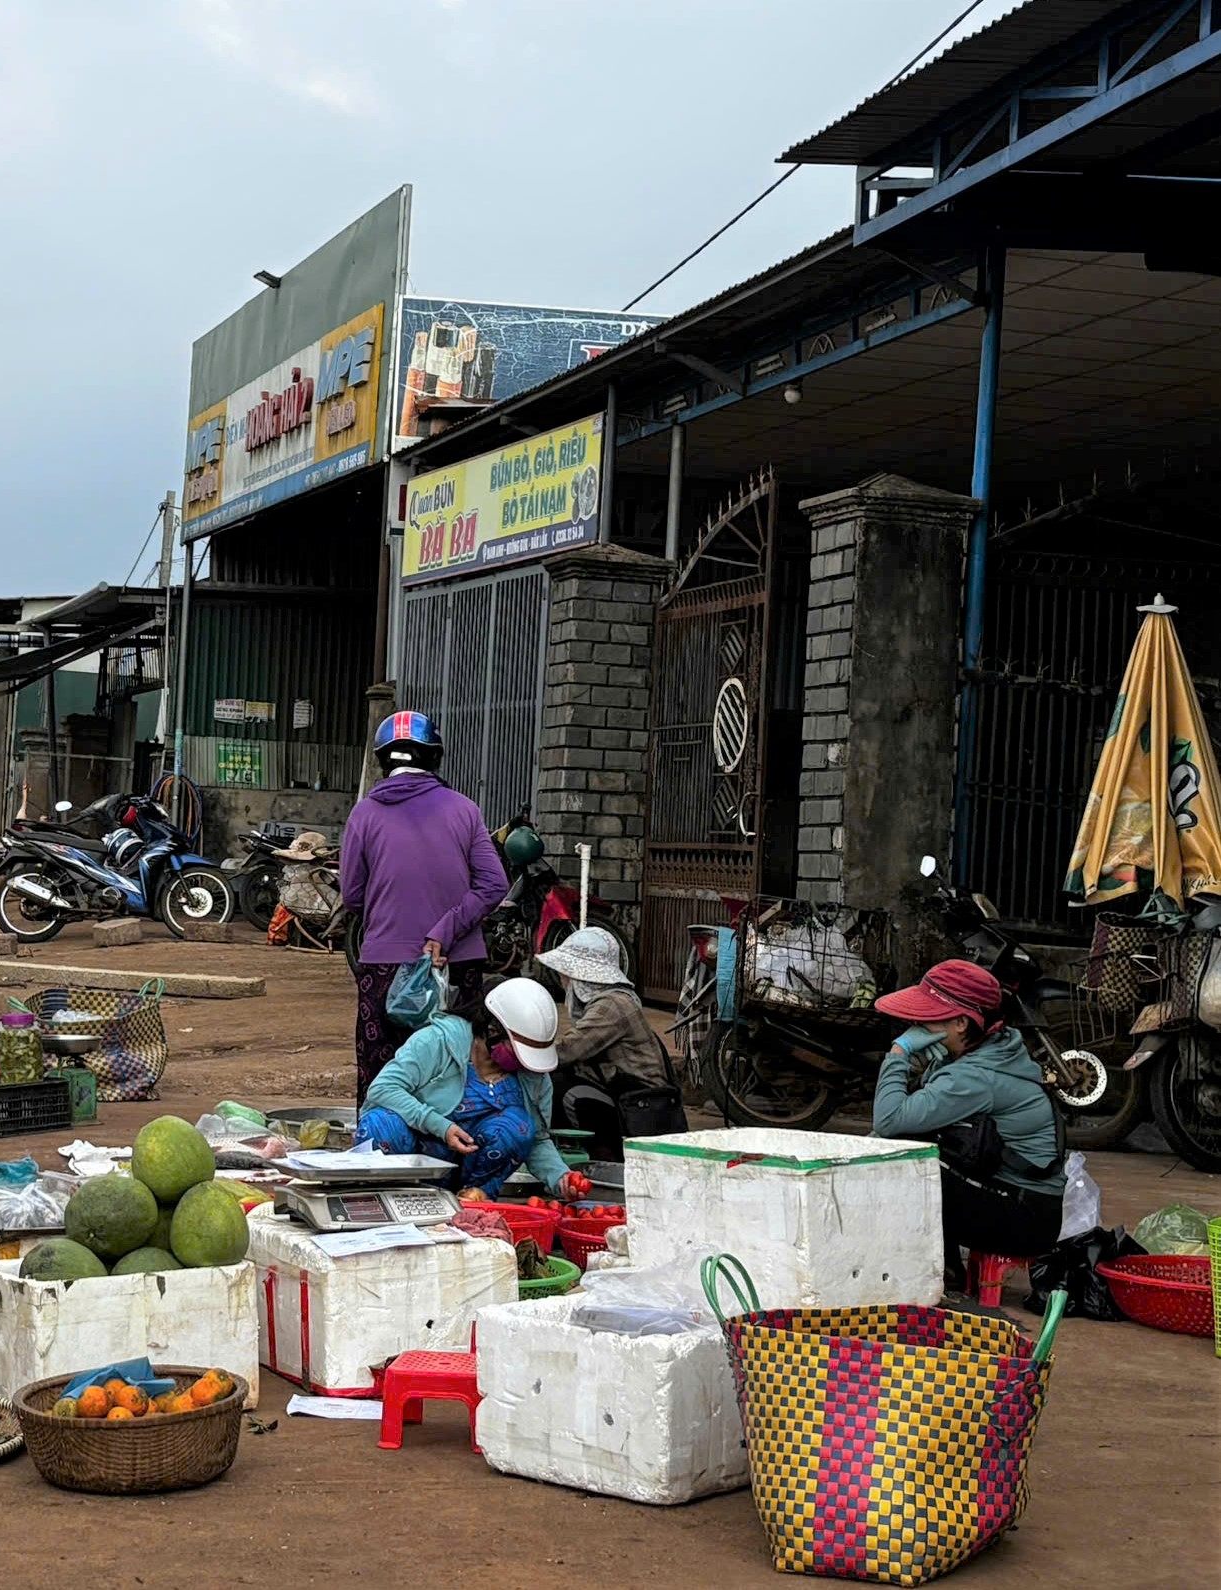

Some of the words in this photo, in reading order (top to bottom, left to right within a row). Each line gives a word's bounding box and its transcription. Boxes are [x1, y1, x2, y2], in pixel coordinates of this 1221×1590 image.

[315, 327, 375, 404] MPE
[186, 416, 225, 474] MPE
[246, 391, 282, 452] HOÀNG
[490, 452, 512, 493] BÚN
[558, 427, 587, 471] RIÊU
[434, 475, 455, 512] BÚN
[502, 487, 519, 528] BÒ
[519, 482, 540, 523] TÁI
